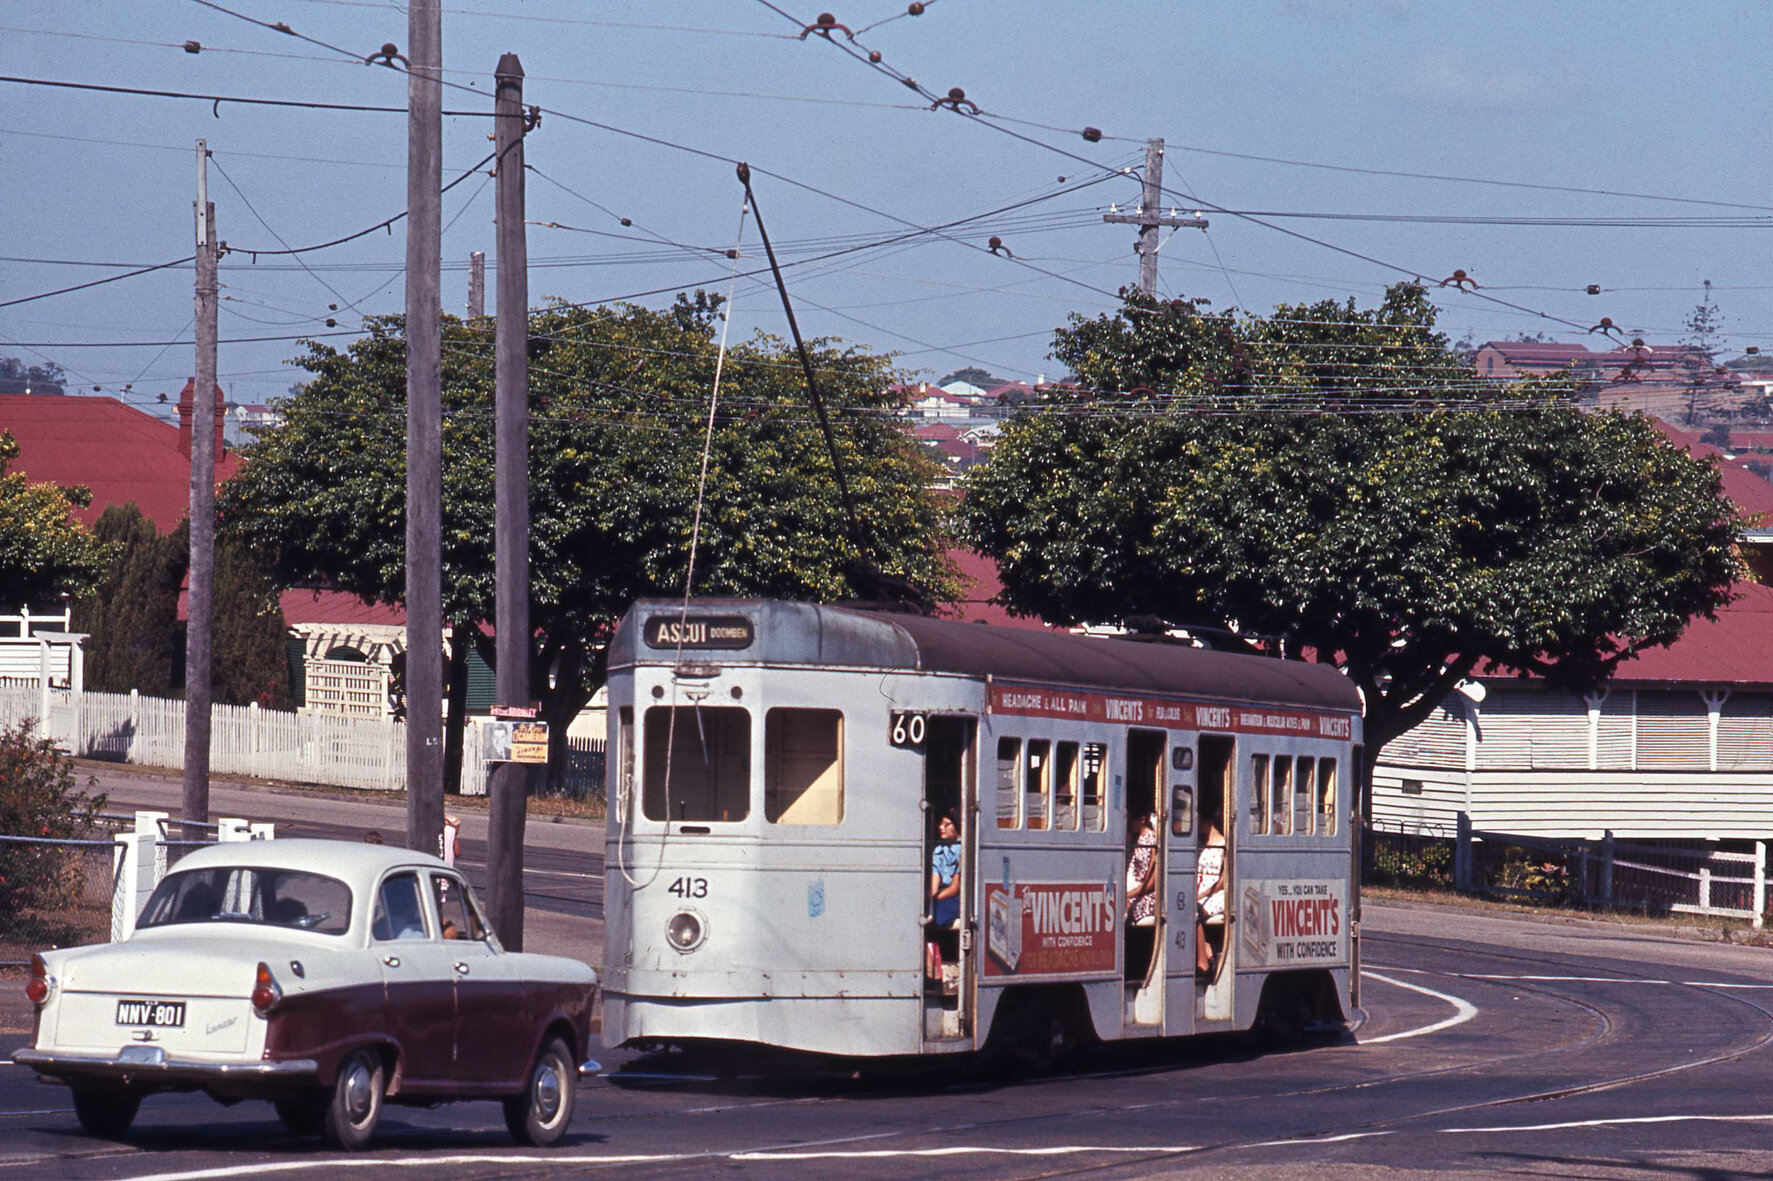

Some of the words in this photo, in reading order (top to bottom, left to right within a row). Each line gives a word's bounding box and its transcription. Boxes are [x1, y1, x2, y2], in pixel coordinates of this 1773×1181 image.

[1002, 693, 1042, 709] HEADACHE
[1050, 697, 1066, 712] ALL
[1068, 699, 1086, 714] PAIN
[1105, 699, 1143, 721] VINCENT'S
[1195, 706, 1230, 728] VINCENT'S
[1319, 716, 1349, 738] VINCENT'S
[892, 714, 926, 744] 60
[668, 877, 708, 898] 413
[1303, 885, 1314, 895] CAN
[1315, 884, 1328, 895] TAKE
[1031, 883, 1115, 934] VINCENT'S
[1272, 893, 1339, 937] VINCENT'S
[1042, 937, 1056, 948] WITH
[1057, 936, 1093, 948] CONFIDENCE
[1277, 942, 1295, 959] WITH
[1297, 941, 1337, 958] CONFIDENCE
